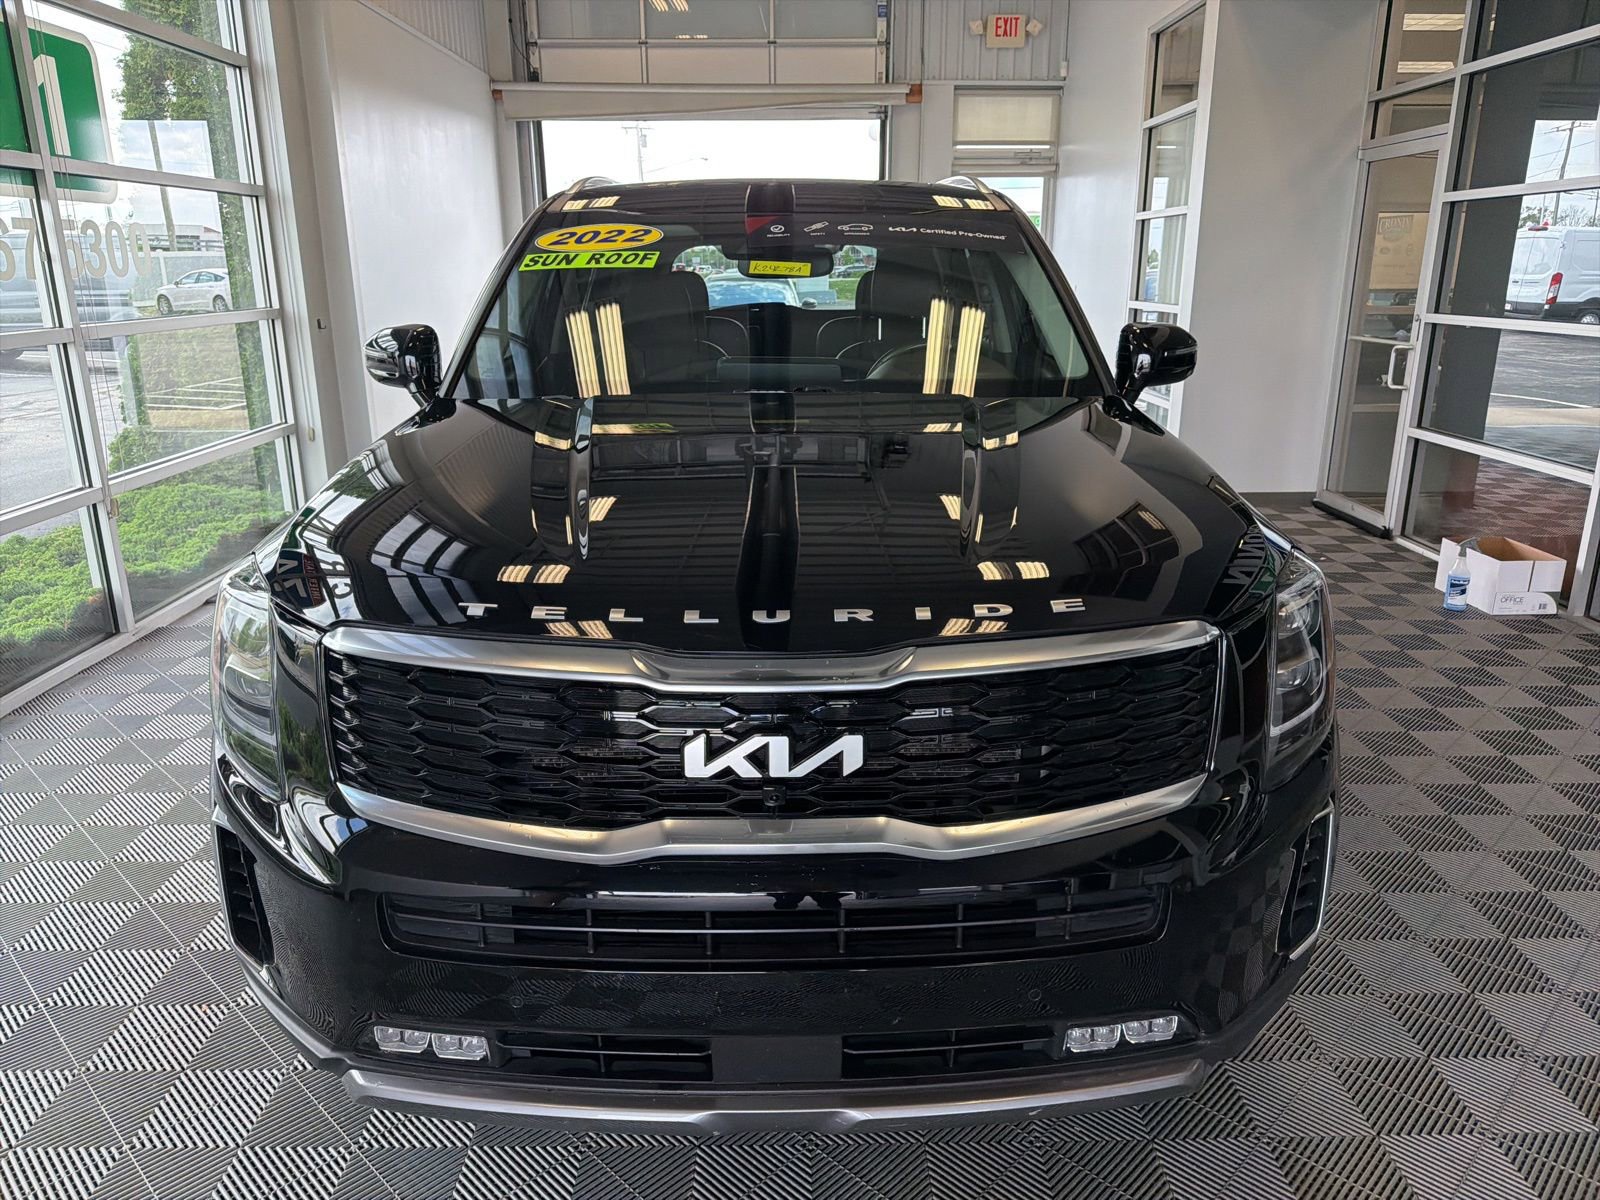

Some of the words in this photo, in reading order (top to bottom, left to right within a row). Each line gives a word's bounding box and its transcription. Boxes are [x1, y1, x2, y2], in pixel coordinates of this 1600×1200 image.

[994, 16, 1020, 38] EXIT
[546, 228, 653, 247] 2022
[920, 227, 957, 236] Certified
[958, 230, 1006, 240] Pre-Owned
[523, 253, 580, 268] SUN
[585, 252, 657, 266] ROOF
[457, 598, 1087, 624] TELLURIDE
[684, 733, 864, 779] KIA
